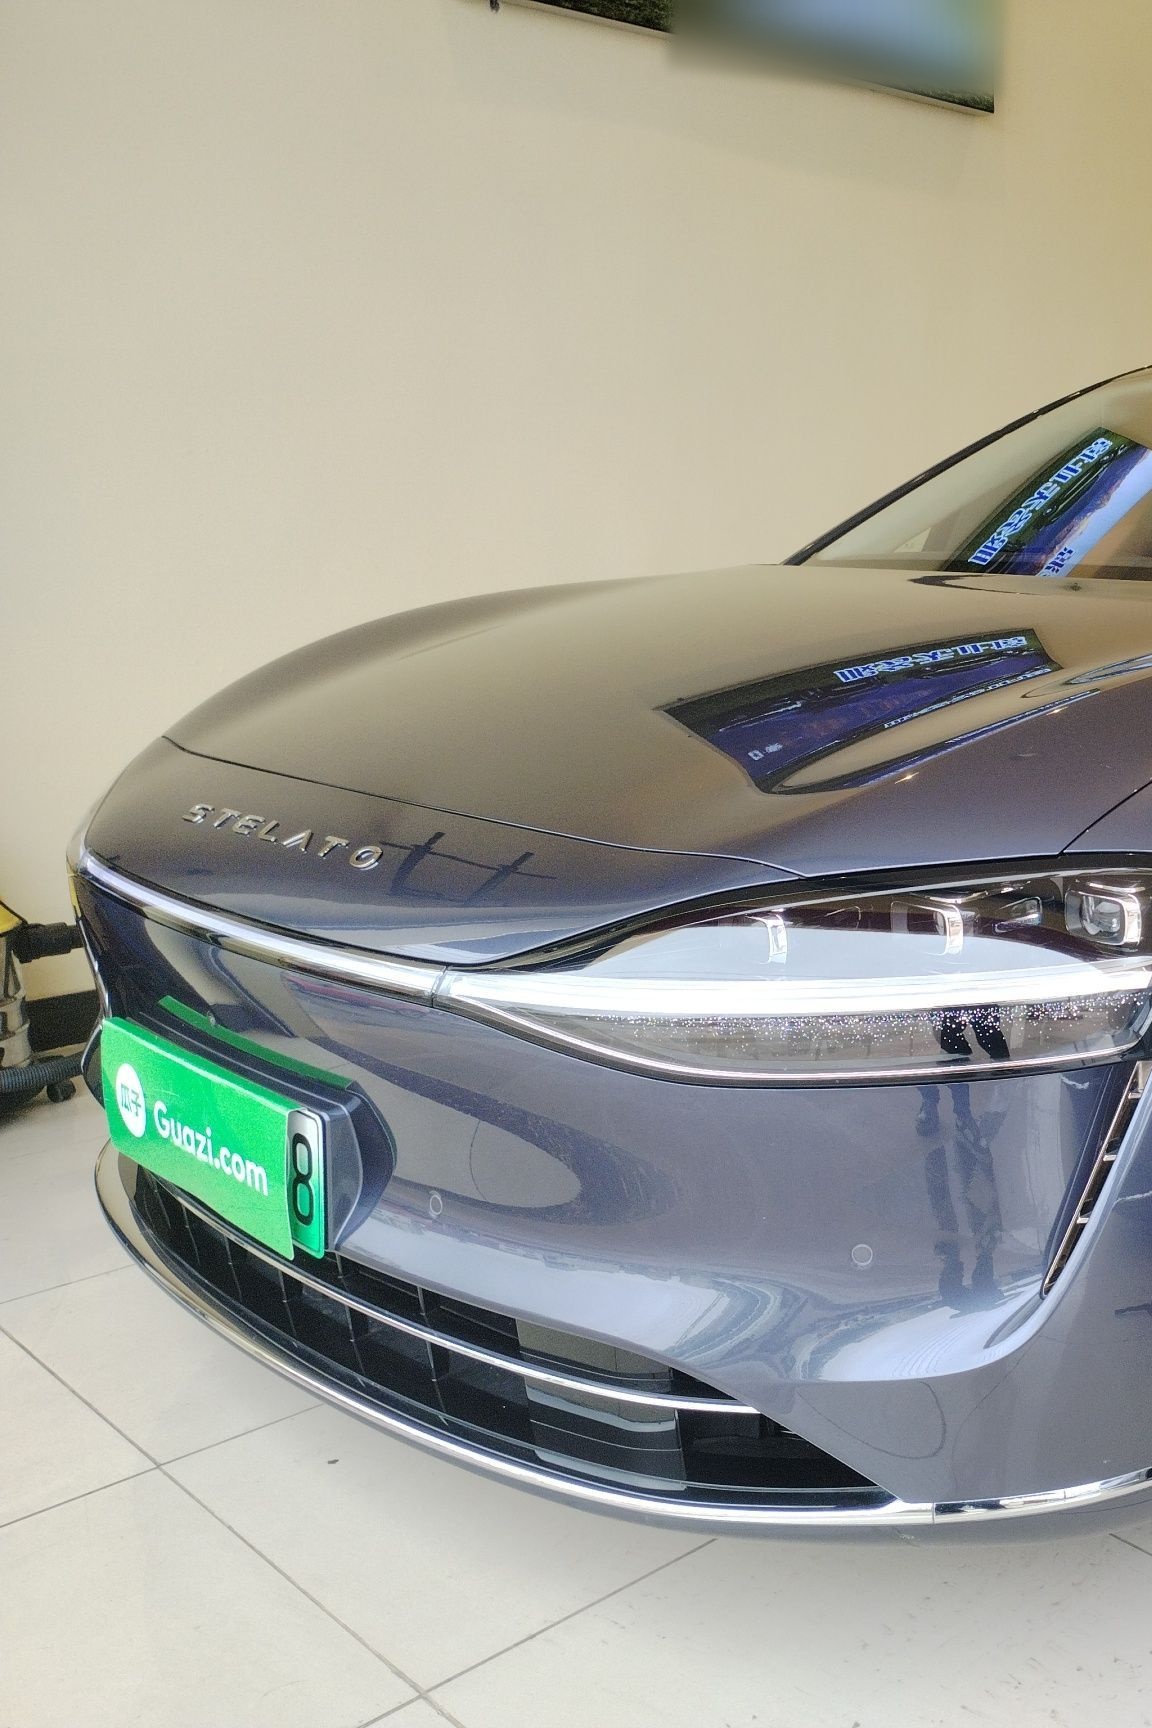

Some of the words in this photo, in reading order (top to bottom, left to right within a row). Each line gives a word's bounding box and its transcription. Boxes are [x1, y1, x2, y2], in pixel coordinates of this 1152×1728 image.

[182, 803, 383, 868] STELATO
[153, 1100, 269, 1197] Guazi.com
[291, 1132, 315, 1227] 8
